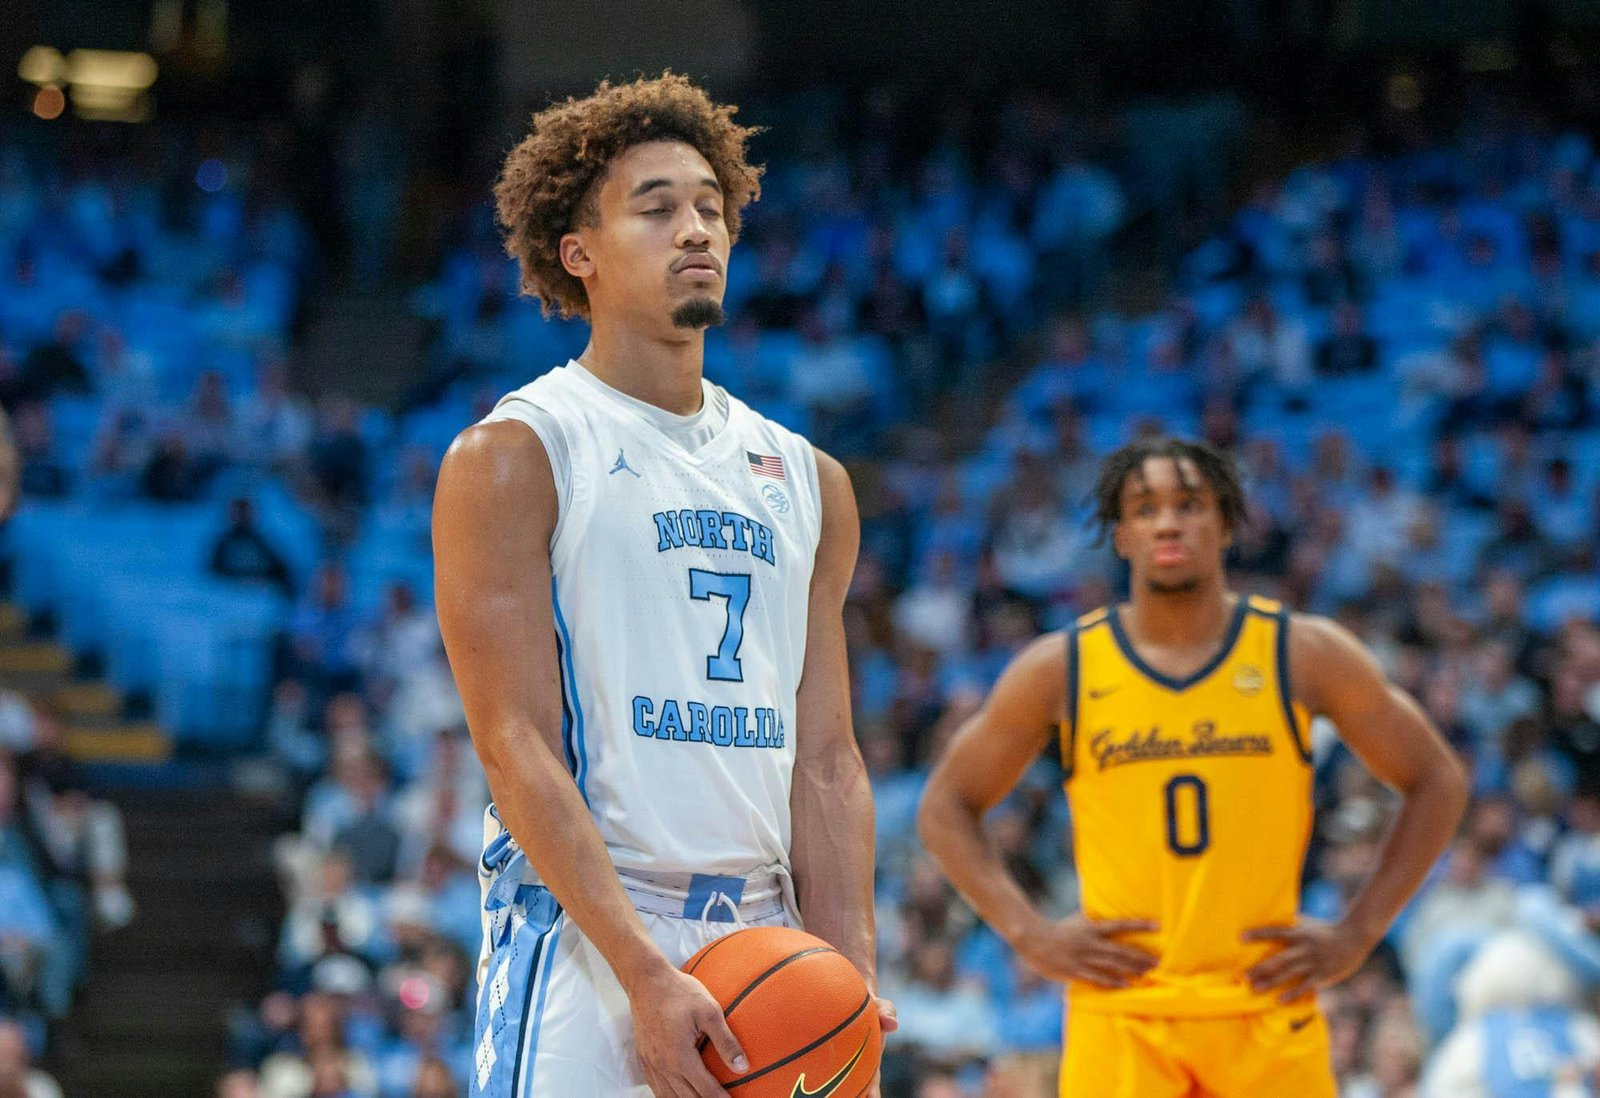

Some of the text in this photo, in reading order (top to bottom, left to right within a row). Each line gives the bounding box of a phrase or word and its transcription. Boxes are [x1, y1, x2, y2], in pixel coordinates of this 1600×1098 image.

[653, 509, 775, 566] NORTH
[689, 568, 751, 682] 7
[1165, 774, 1209, 857] 0
